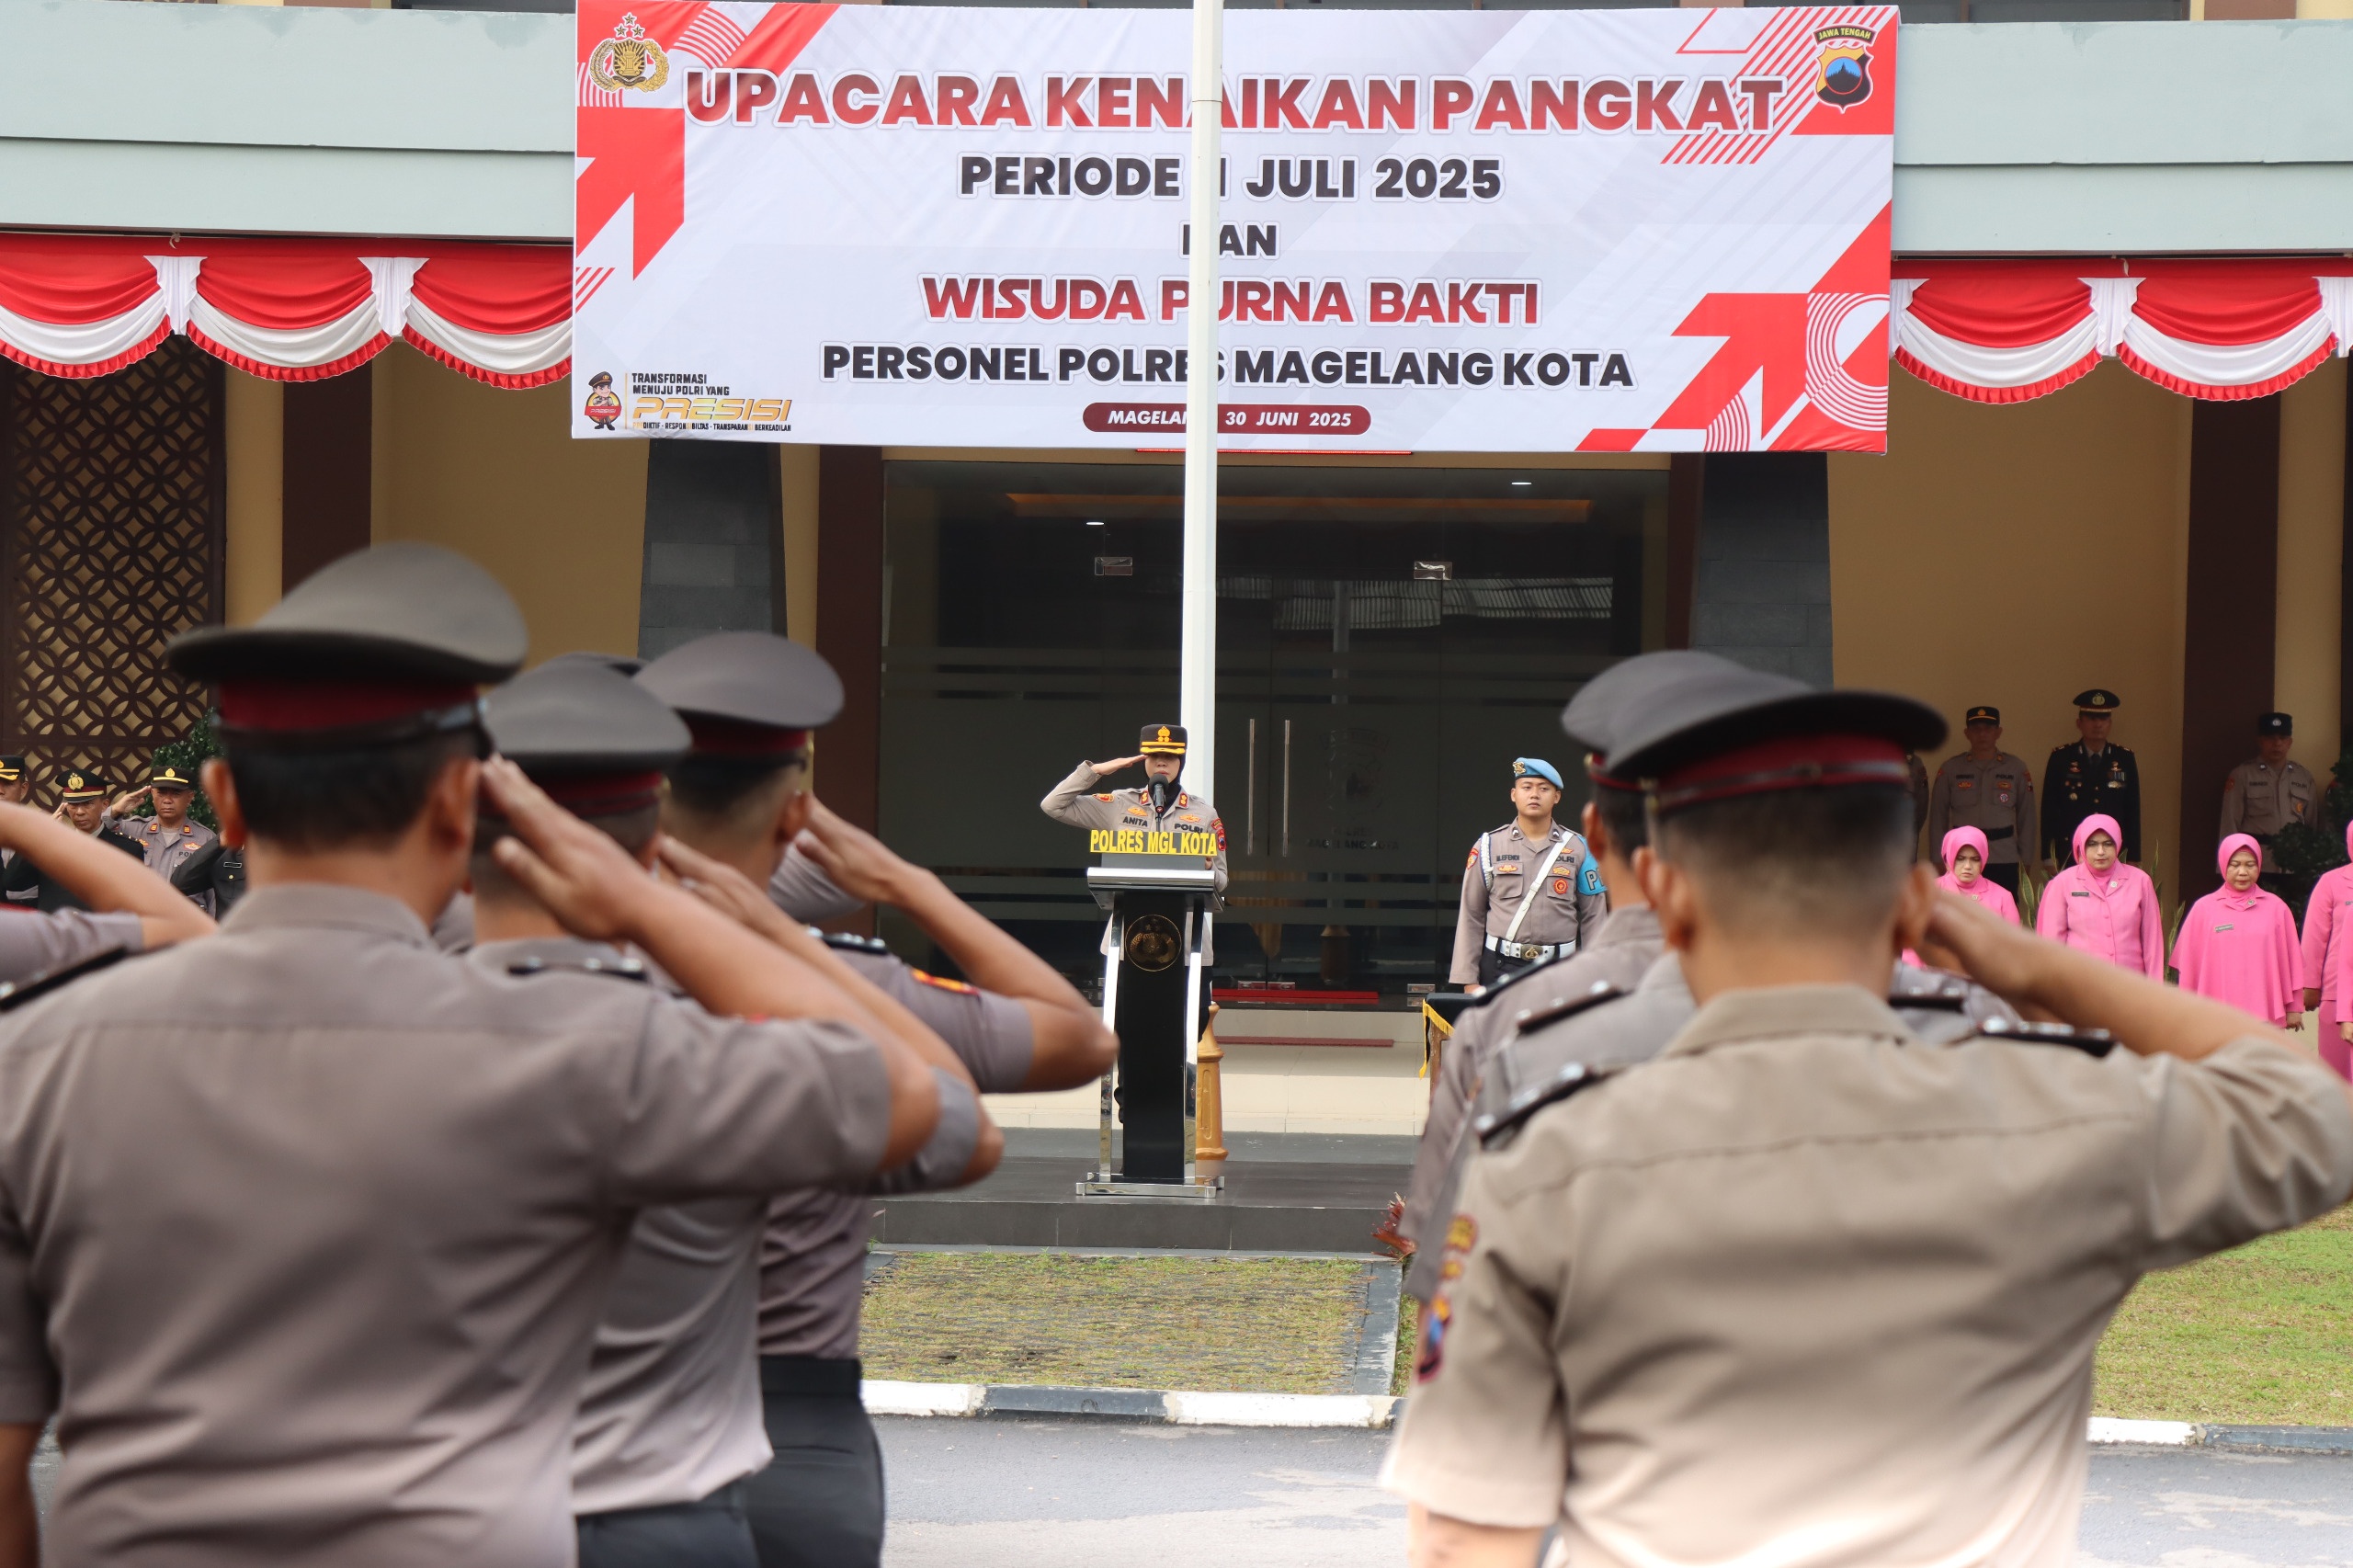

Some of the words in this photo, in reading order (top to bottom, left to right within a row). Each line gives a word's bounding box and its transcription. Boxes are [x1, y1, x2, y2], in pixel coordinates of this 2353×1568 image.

[1819, 28, 1839, 40] JAWA
[1840, 27, 1871, 40] TENGAH
[687, 72, 1032, 127] UPACARA
[1433, 79, 1783, 131] PANGKAT
[961, 156, 1180, 197] PERIODE
[1245, 159, 1355, 199] JULI
[1375, 158, 1501, 199] 2025
[1182, 224, 1277, 256] AN
[922, 278, 1146, 320] WISUDA
[1370, 281, 1538, 324] BAKTI
[631, 372, 707, 384] TRANSFORMASI
[824, 346, 1049, 380] PERSONEL
[1235, 349, 1494, 385] MAGELANG
[1503, 353, 1633, 386] KOTA
[632, 384, 674, 395] MENUJU
[676, 386, 703, 395] POLRI
[706, 386, 730, 396] YANG
[632, 397, 792, 422] PRESISI
[1225, 412, 1246, 426] 30
[1256, 412, 1299, 426] JUNI
[1309, 413, 1352, 427] 2025
[1122, 815, 1148, 828] ANITA
[1174, 823, 1203, 834] POLRI
[1090, 829, 1144, 853] POLRES
[1147, 831, 1177, 855] MGL
[1180, 832, 1217, 856] KOTA
